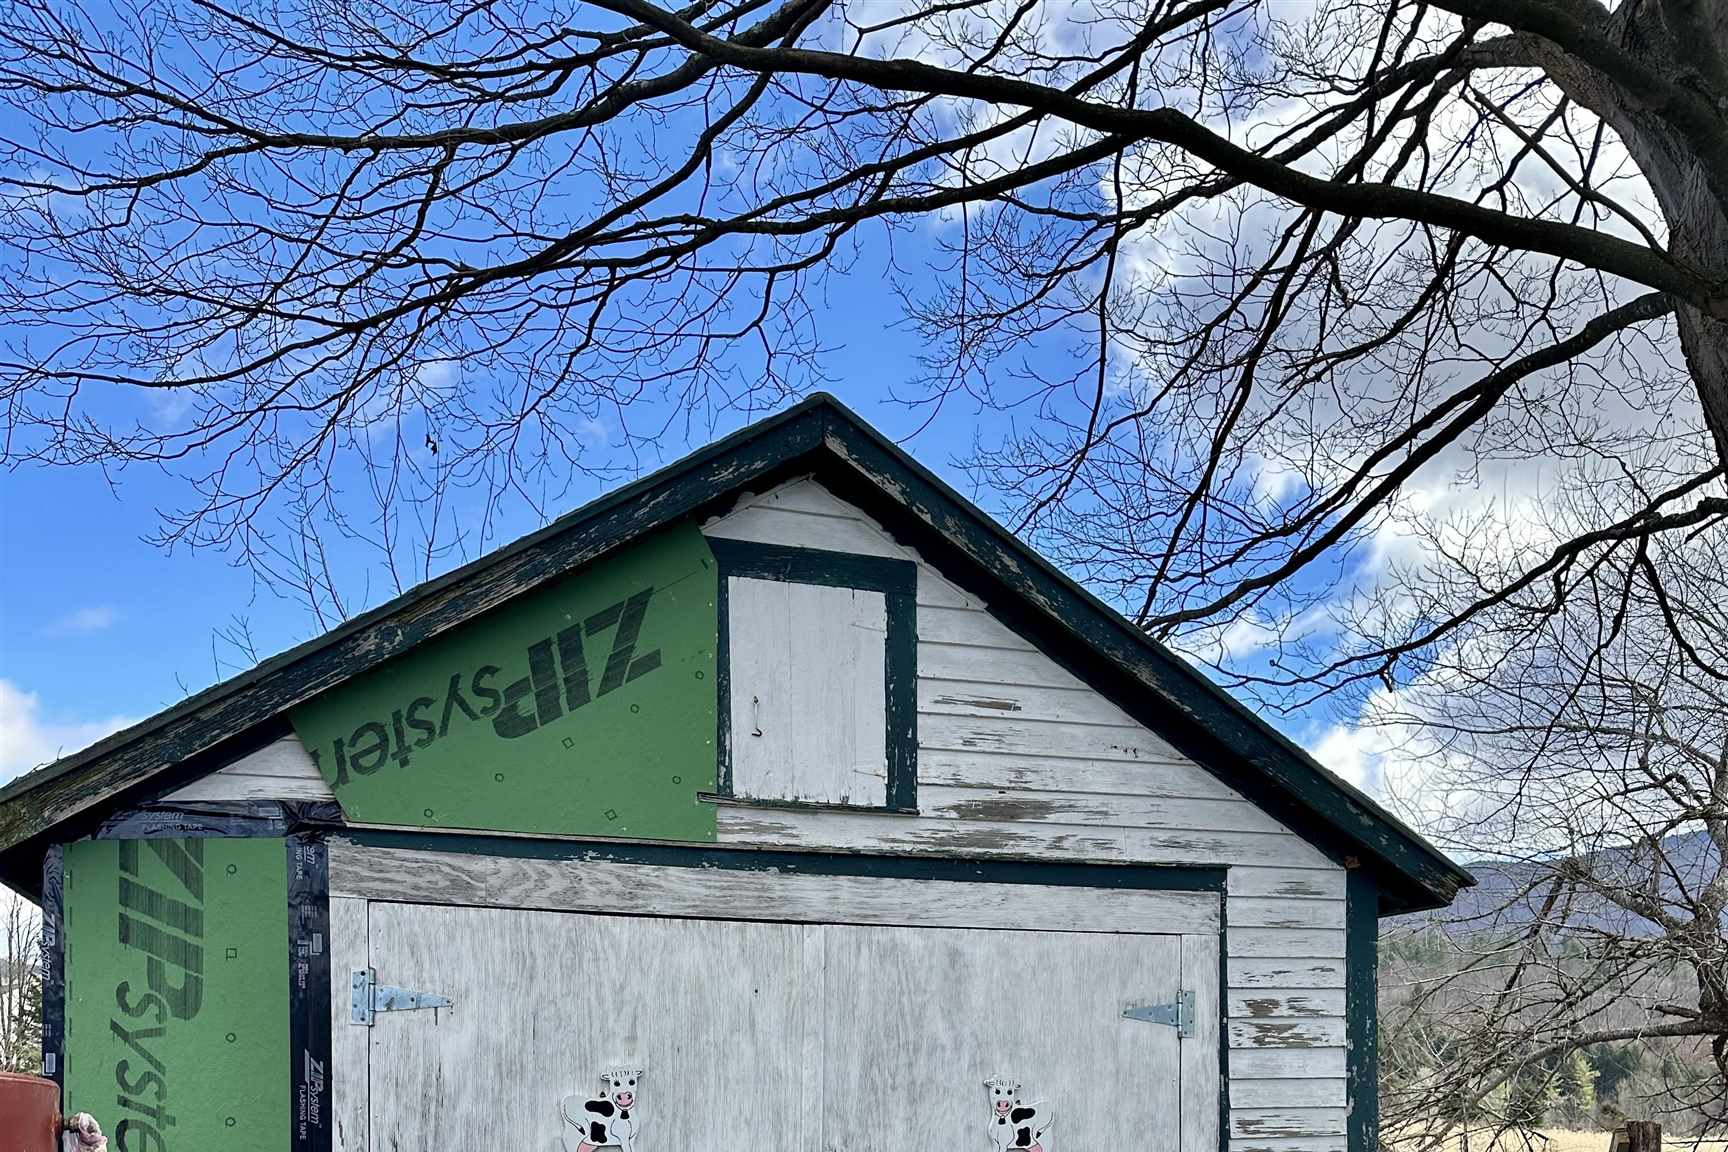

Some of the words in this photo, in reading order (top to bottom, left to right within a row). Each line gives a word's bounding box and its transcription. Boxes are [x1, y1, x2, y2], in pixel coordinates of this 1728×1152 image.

[184, 823, 203, 831] TAPE
[299, 1085, 307, 1121] FLASHING
[299, 1122, 307, 1140] TAPE
